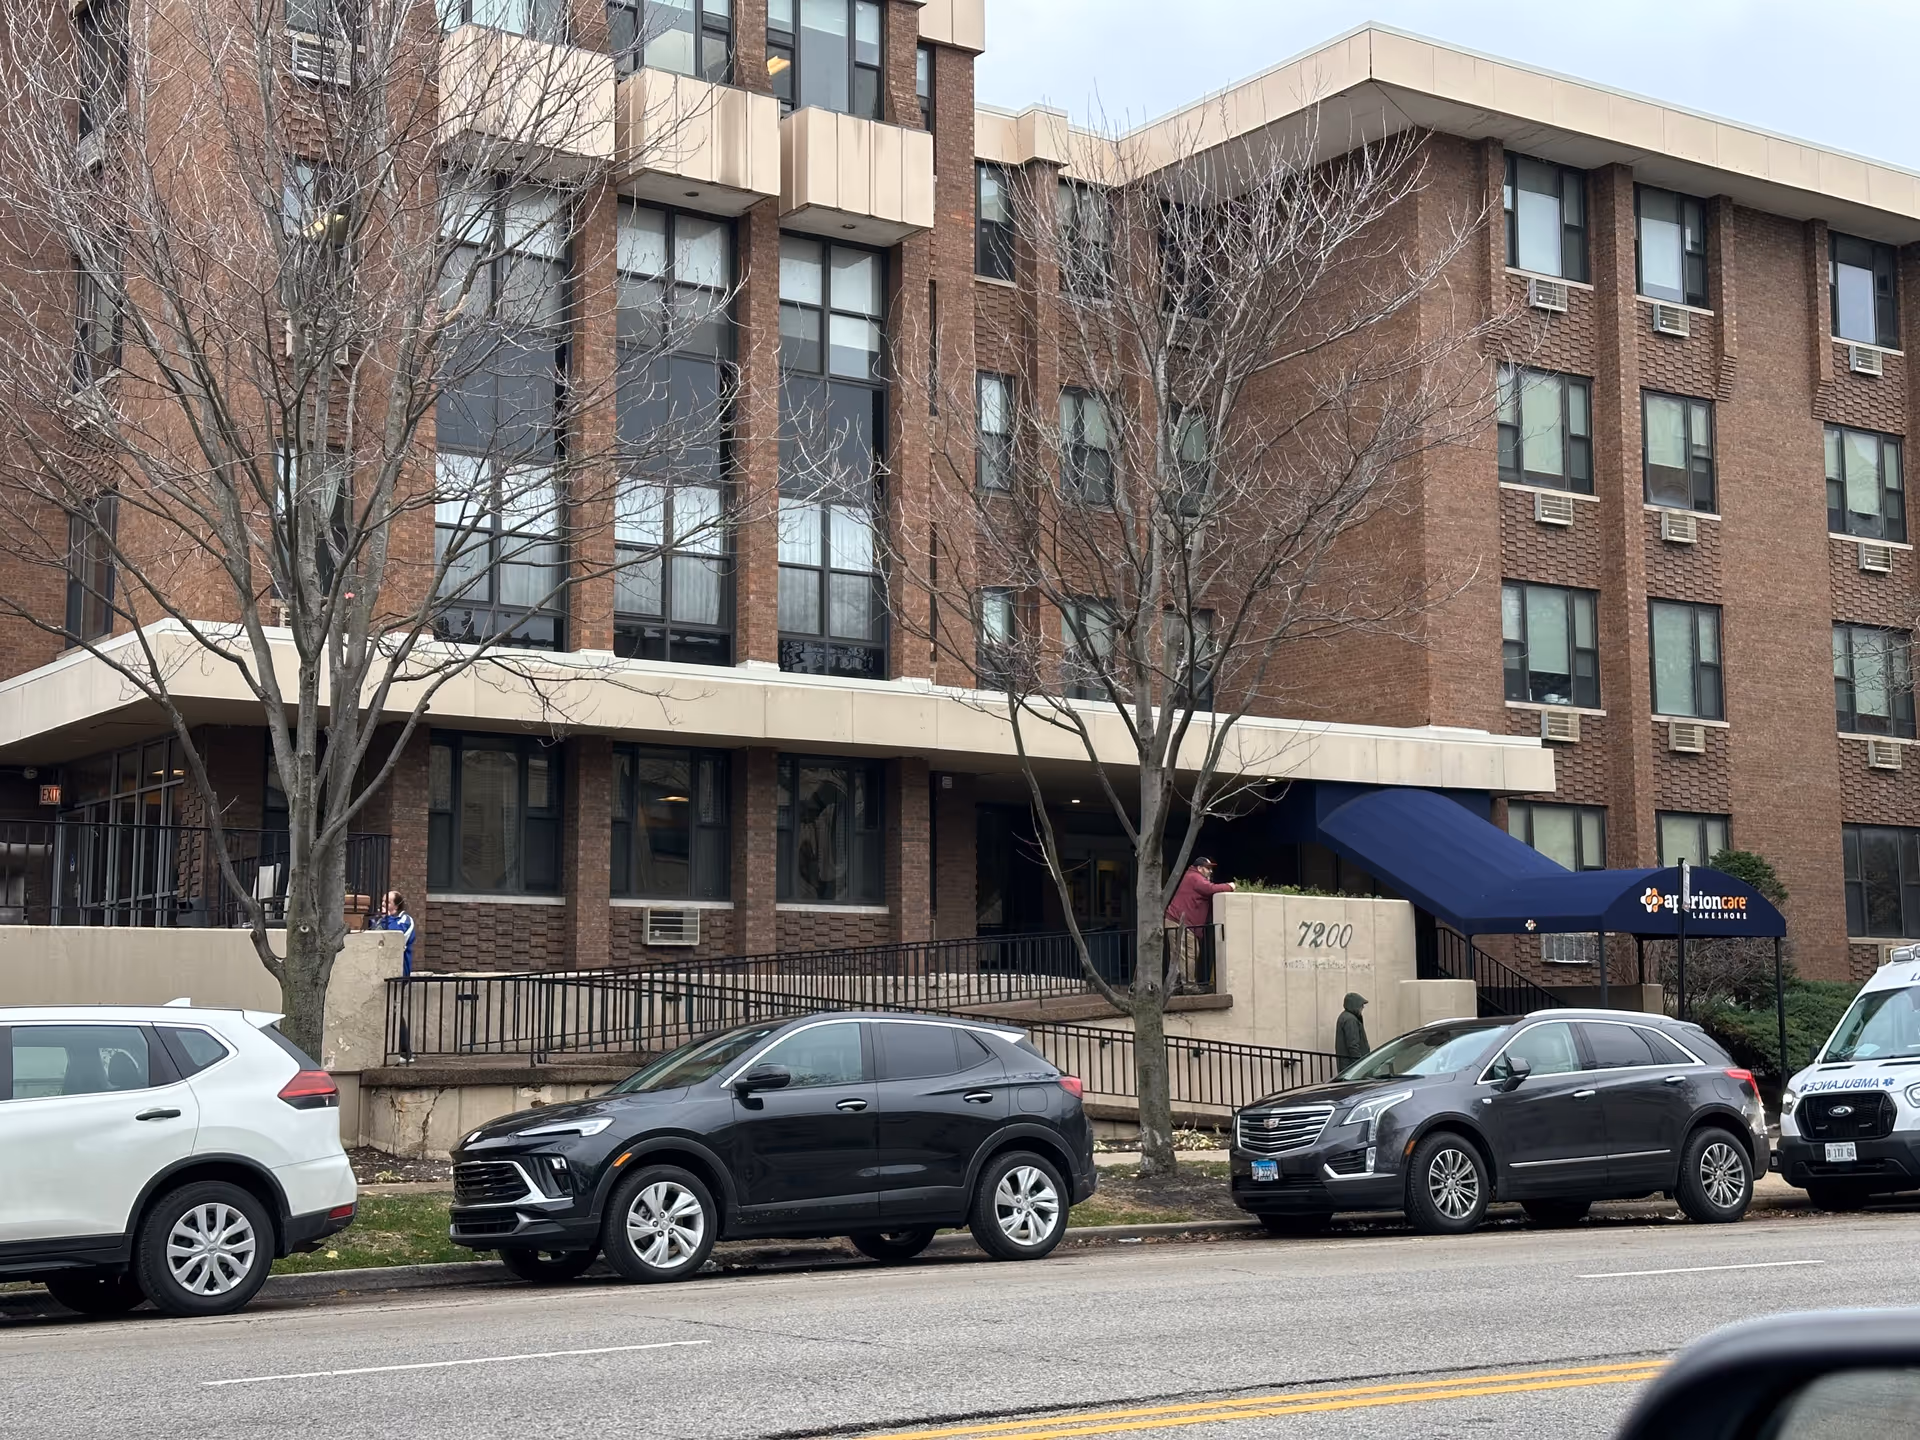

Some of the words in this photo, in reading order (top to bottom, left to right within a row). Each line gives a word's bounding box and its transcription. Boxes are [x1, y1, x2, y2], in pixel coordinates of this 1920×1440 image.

[42, 788, 59, 801] EXIT
[1664, 890, 1747, 914] aprioncare
[1692, 911, 1747, 920] LAKESHORE
[1297, 920, 1353, 949] 7200
